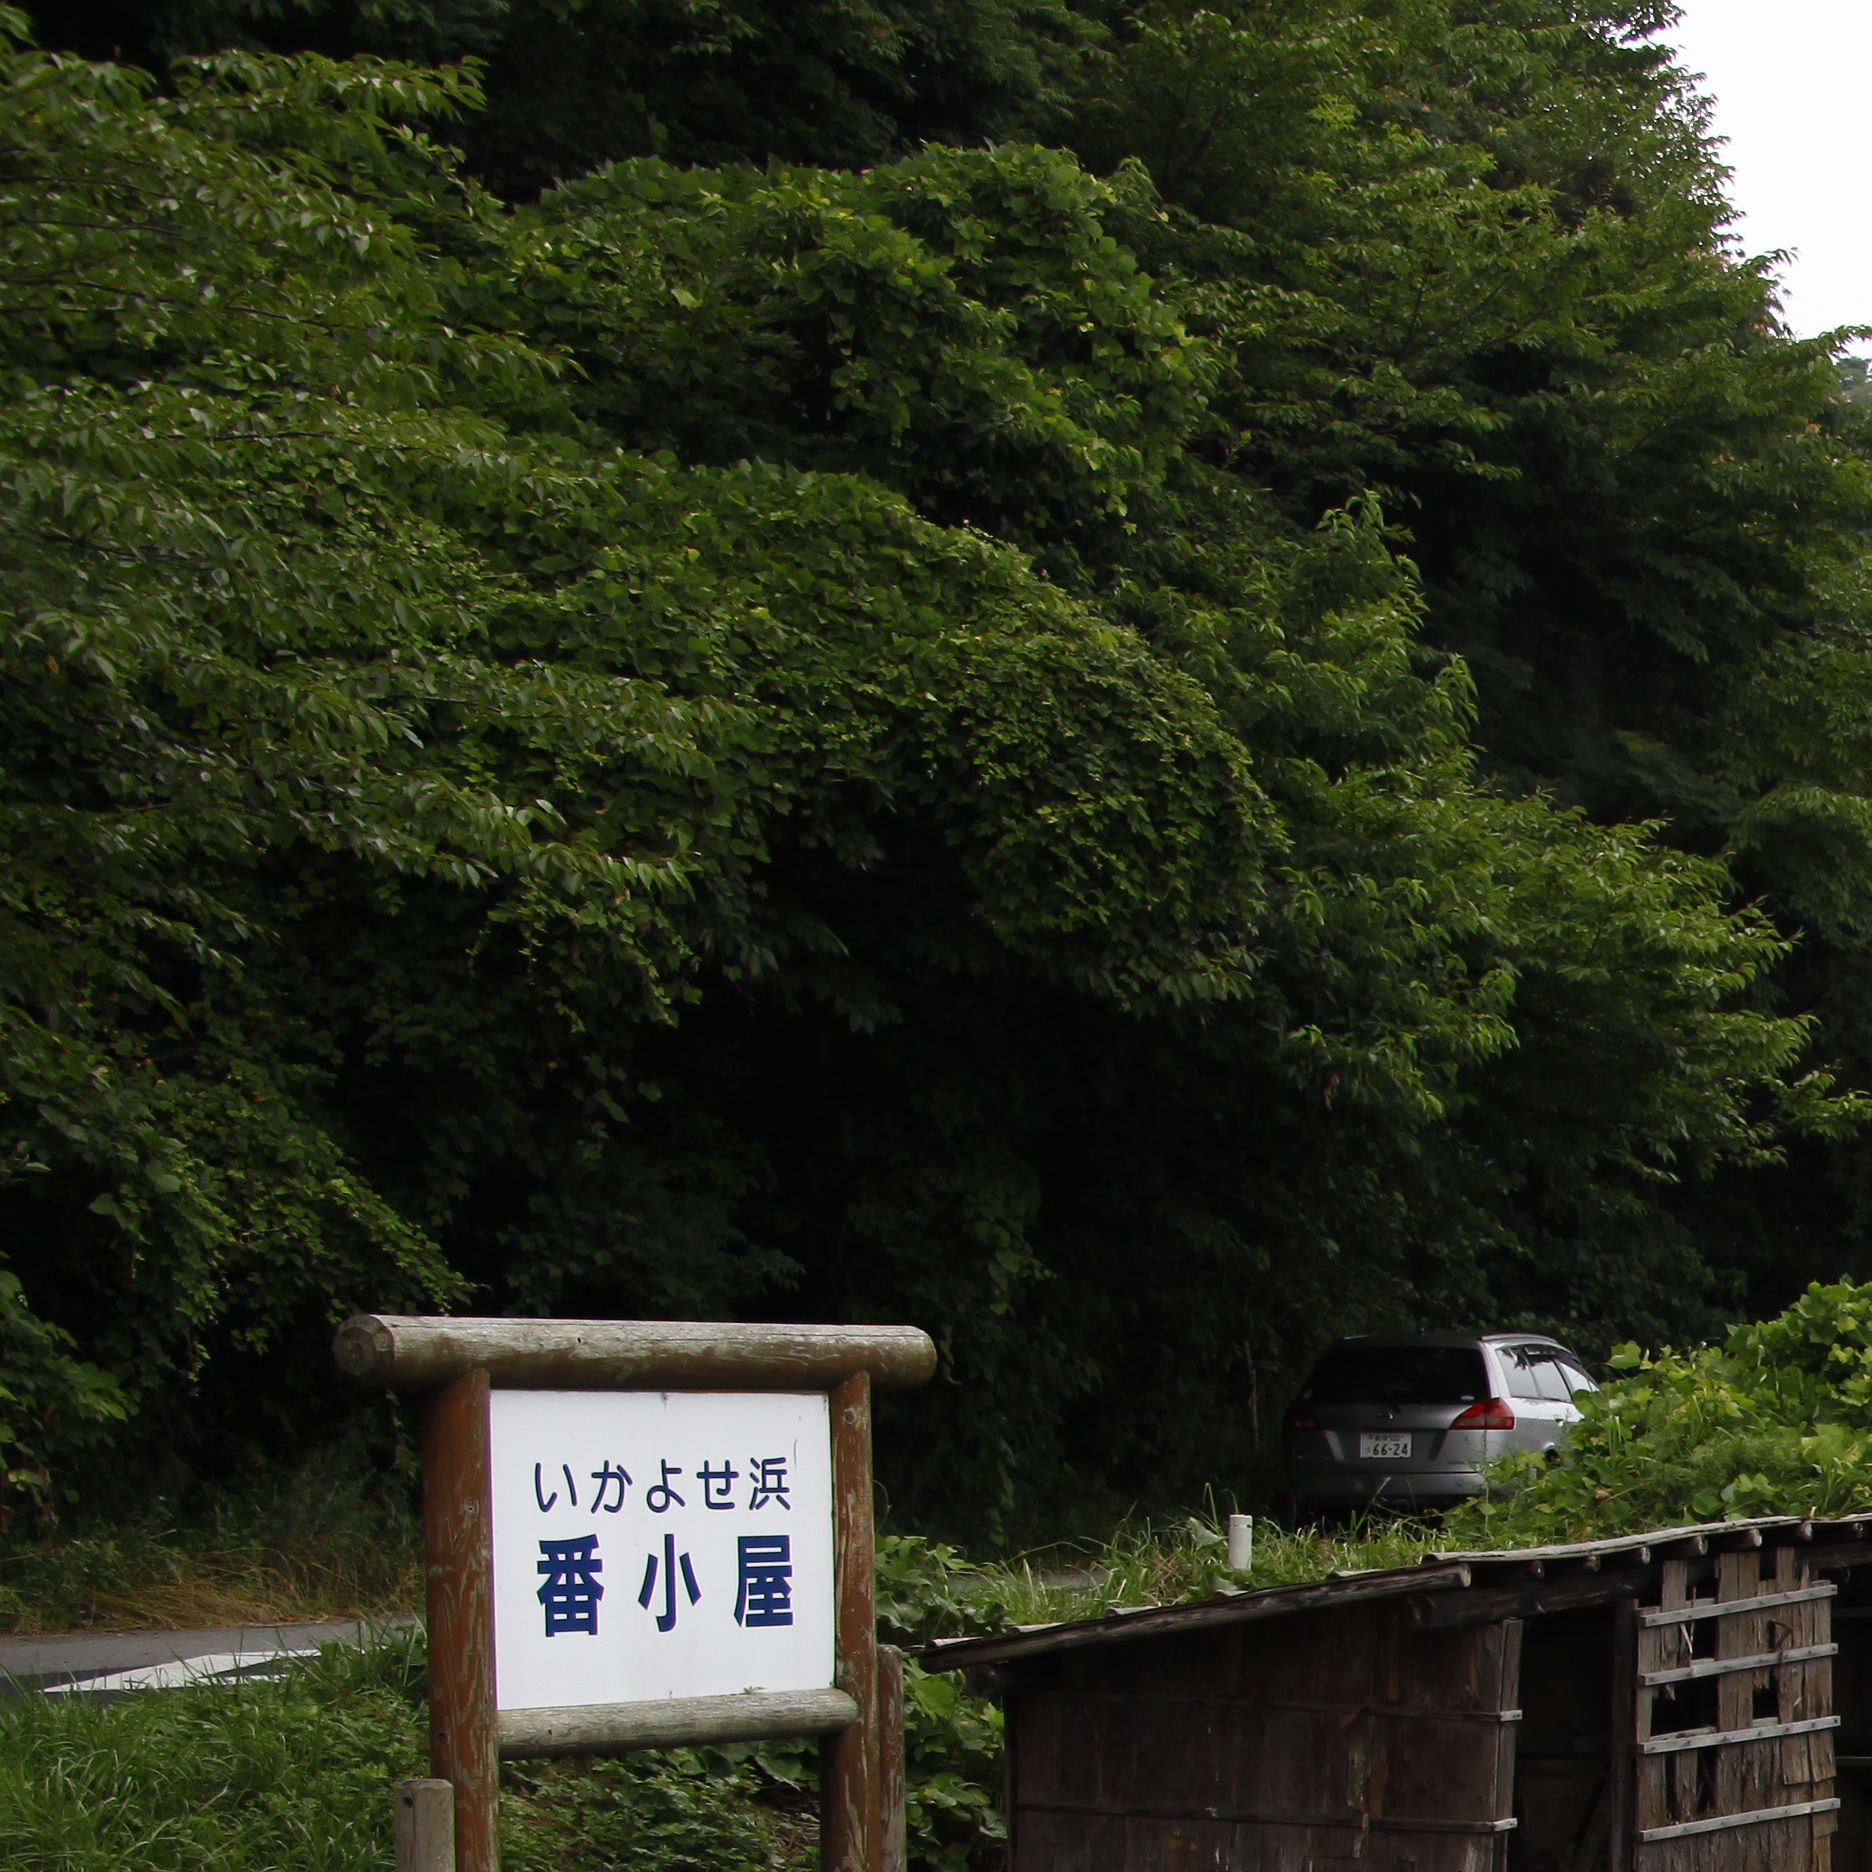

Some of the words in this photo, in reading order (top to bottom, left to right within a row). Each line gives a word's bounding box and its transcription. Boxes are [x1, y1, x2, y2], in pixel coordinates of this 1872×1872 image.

[534, 1457, 791, 1514] いかよせ浜
[536, 1533, 795, 1638] 番小屋
